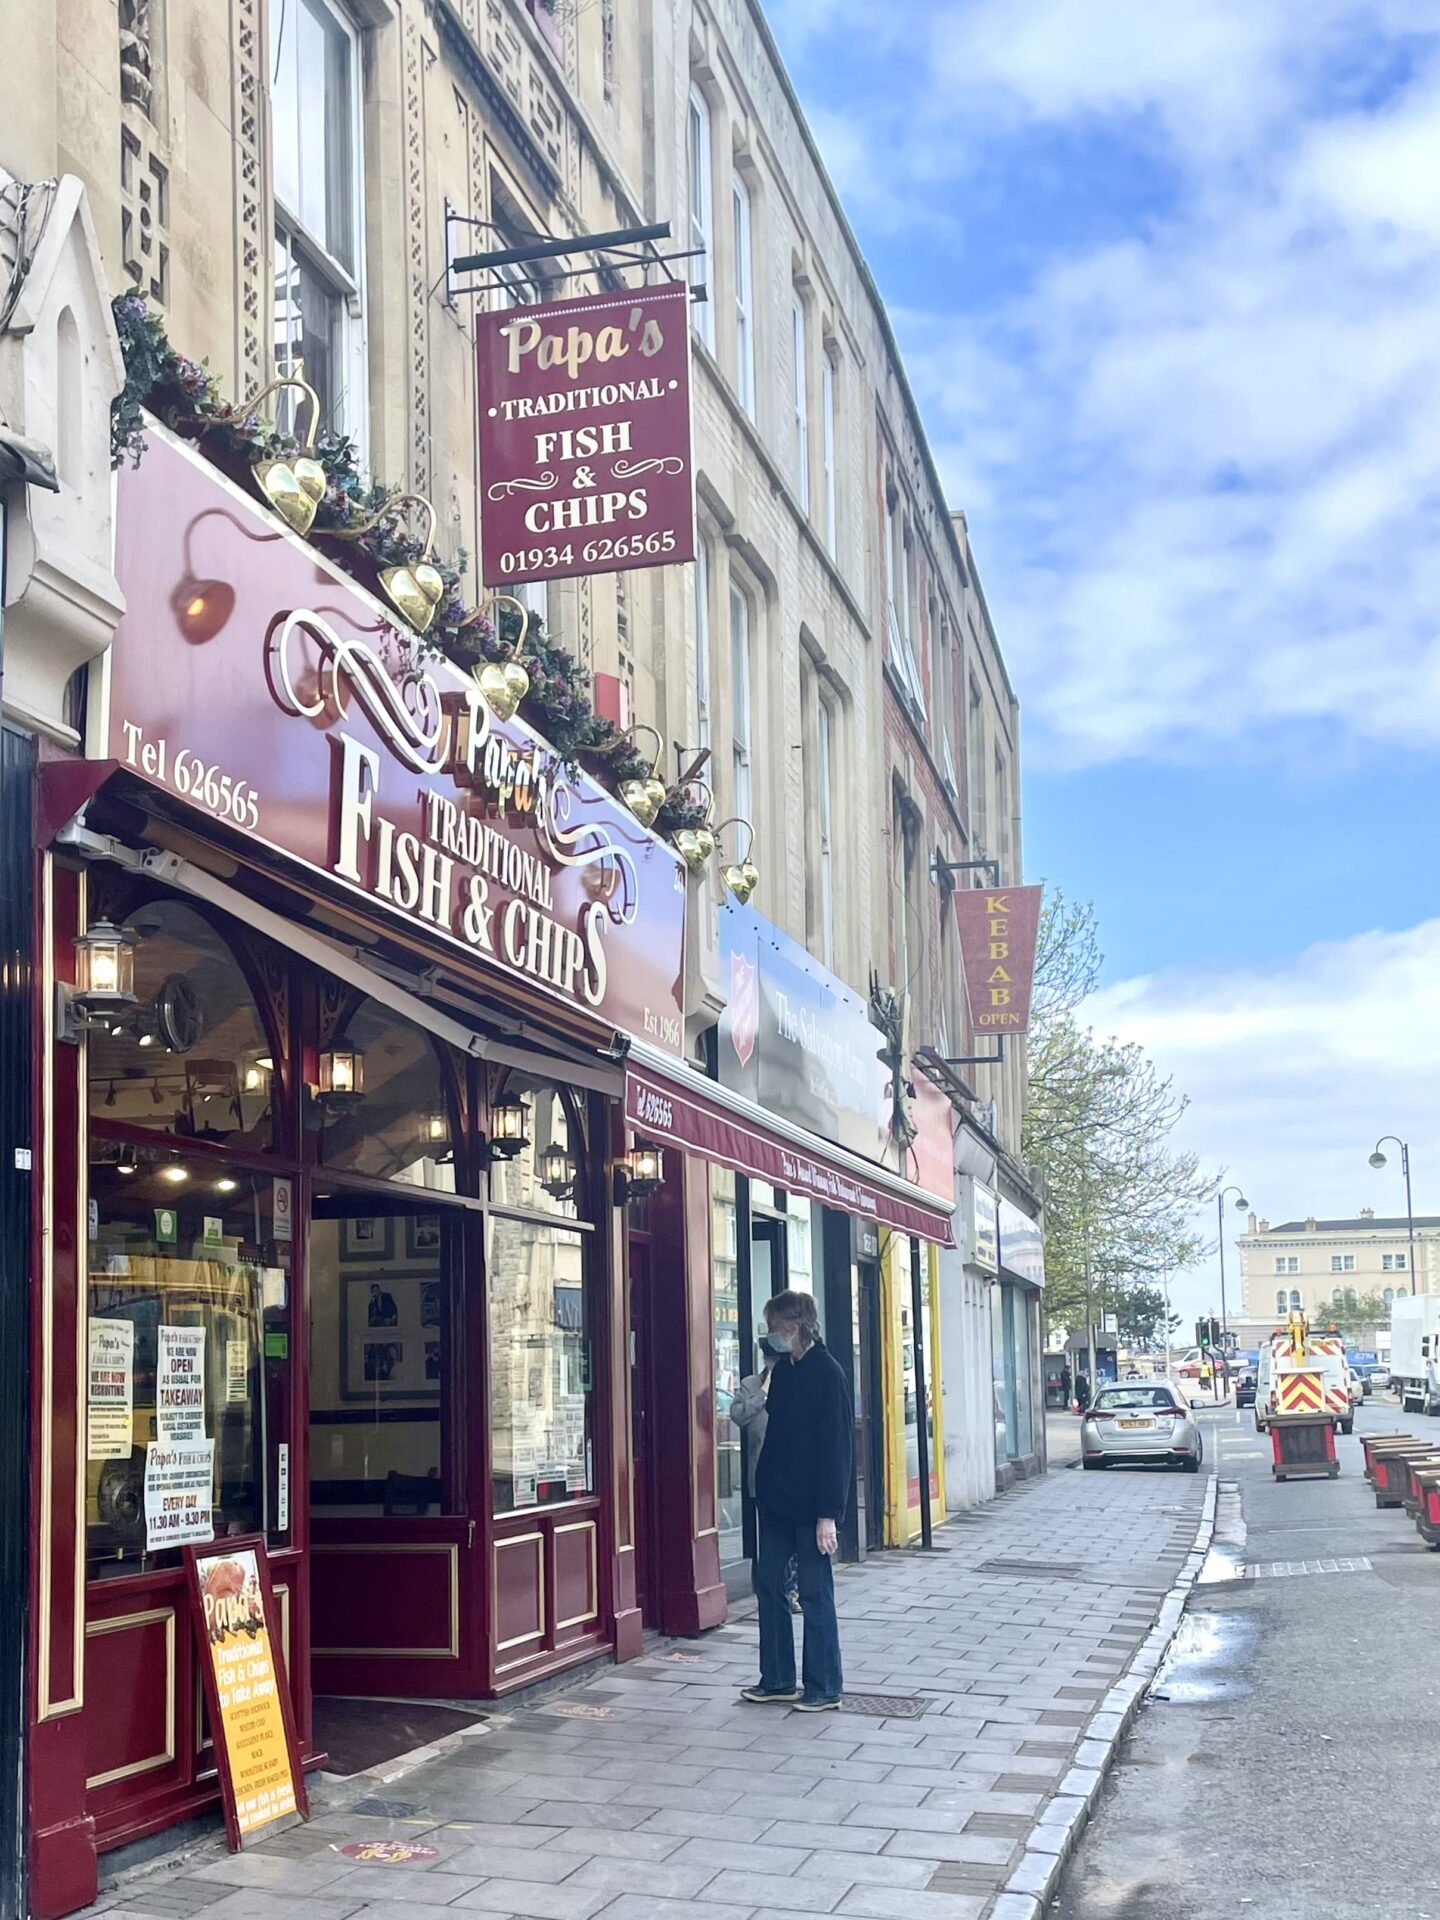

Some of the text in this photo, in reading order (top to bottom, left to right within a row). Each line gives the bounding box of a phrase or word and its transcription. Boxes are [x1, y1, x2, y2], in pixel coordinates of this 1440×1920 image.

[500, 307, 664, 379] Papa's
[501, 378, 665, 421] TRADITIONAL
[534, 421, 632, 464] FISH
[572, 466, 597, 489] &
[524, 489, 648, 533] CHIPS
[500, 530, 676, 573] 01934 626565
[122, 719, 260, 830] Tel 626565
[465, 690, 548, 828] Papa's
[427, 789, 554, 911] TRADITIONAL
[333, 731, 608, 1007] FISH & CHIPS
[984, 895, 1013, 1007] KEBAB
[643, 1006, 680, 1047] Est 1966
[776, 990, 798, 1044] The
[799, 1006, 844, 1072] Salvation
[979, 1012, 1020, 1026] OPEN
[166, 1347, 197, 1357] WE ARE NOW
[170, 1358, 193, 1373] OPEN
[91, 1384, 125, 1397] RECRUITING
[162, 1374, 202, 1385] AS USUAL FOR
[160, 1388, 203, 1406] TAKEAWAY
[150, 1447, 177, 1470] Papa's
[162, 1494, 198, 1511] EVERY DAY
[149, 1514, 168, 1531] 11.30
[168, 1513, 180, 1528] AM
[185, 1511, 200, 1526] 9.30
[200, 1510, 211, 1524] PM
[202, 1588, 264, 1632] Papa's
[217, 1638, 264, 1665] Traditional
[218, 1661, 270, 1686] Fish & Chips
[232, 1686, 252, 1704] Take
[252, 1680, 275, 1698] Away
